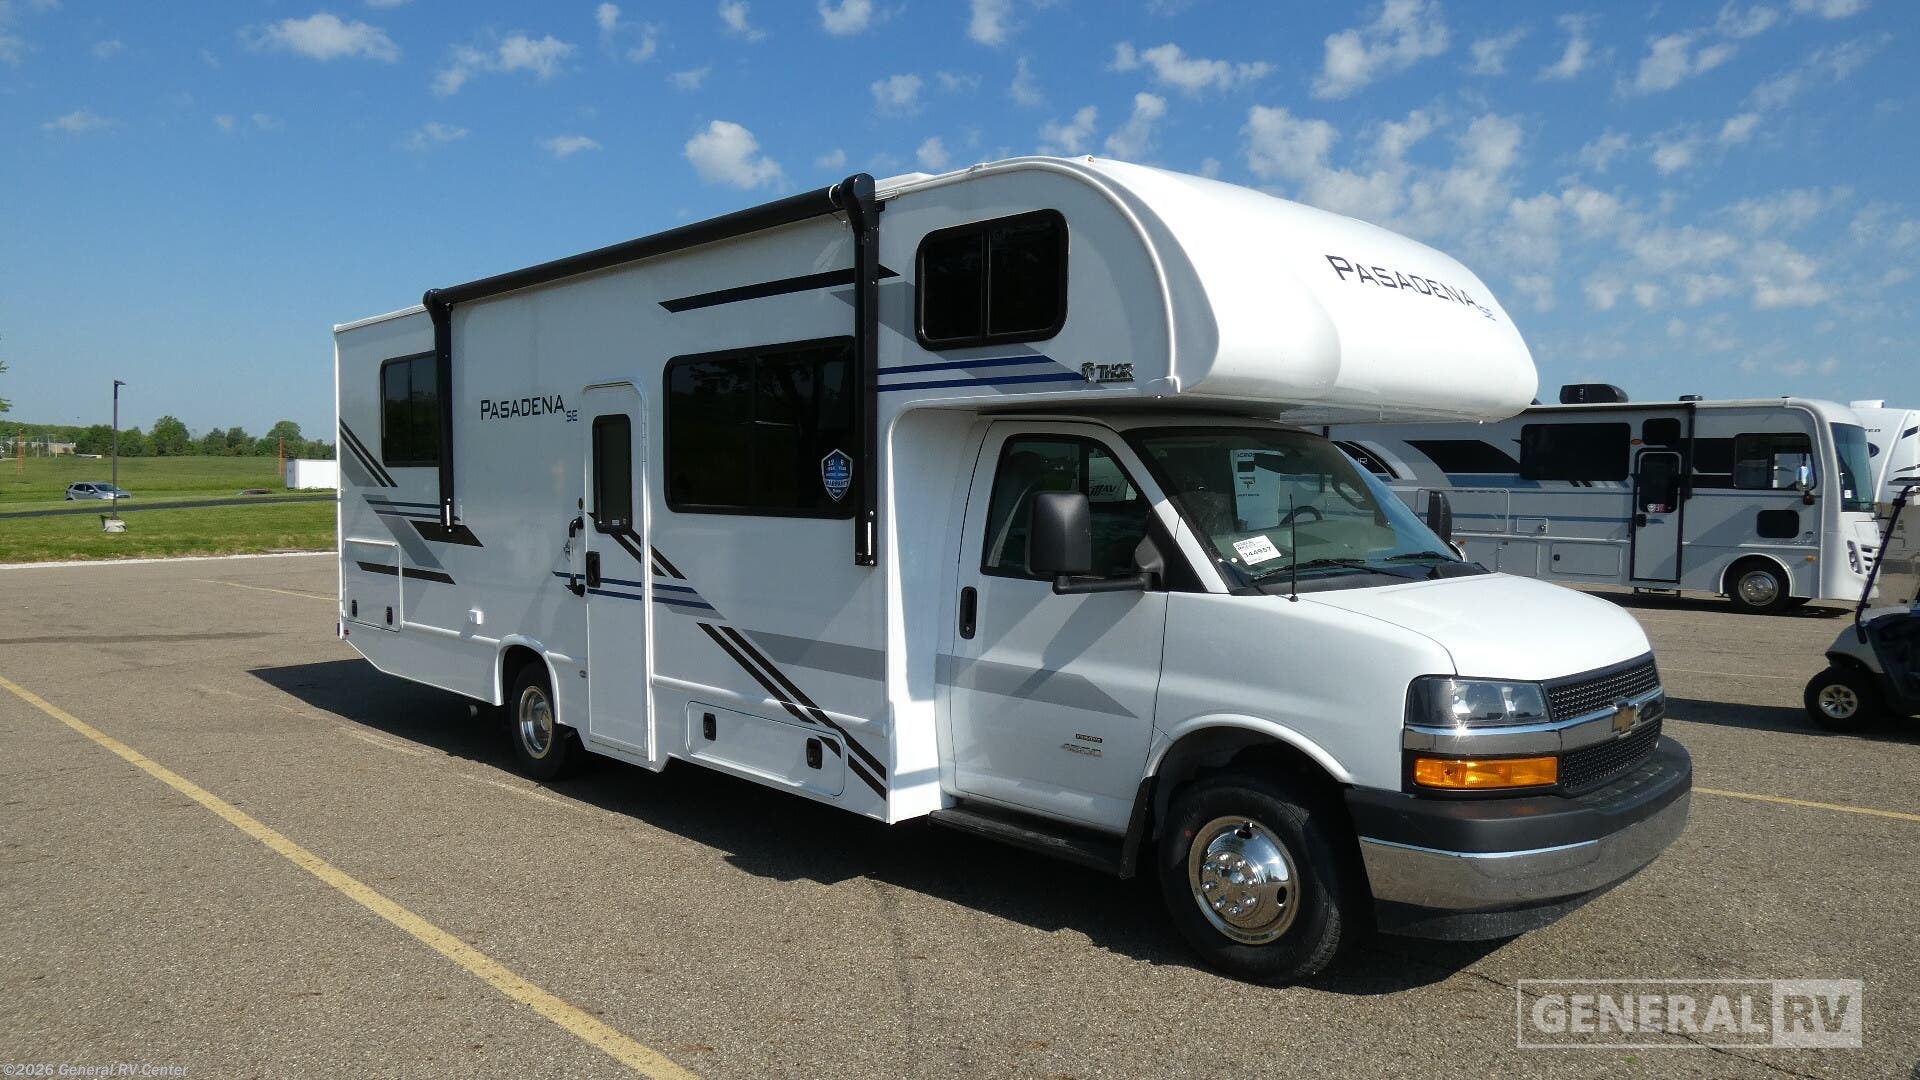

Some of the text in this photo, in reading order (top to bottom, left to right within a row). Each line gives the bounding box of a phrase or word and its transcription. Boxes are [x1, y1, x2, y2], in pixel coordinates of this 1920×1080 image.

[1325, 254, 1480, 309] PASADENA
[1096, 364, 1135, 379] THOR
[481, 394, 565, 420] PASADENA
